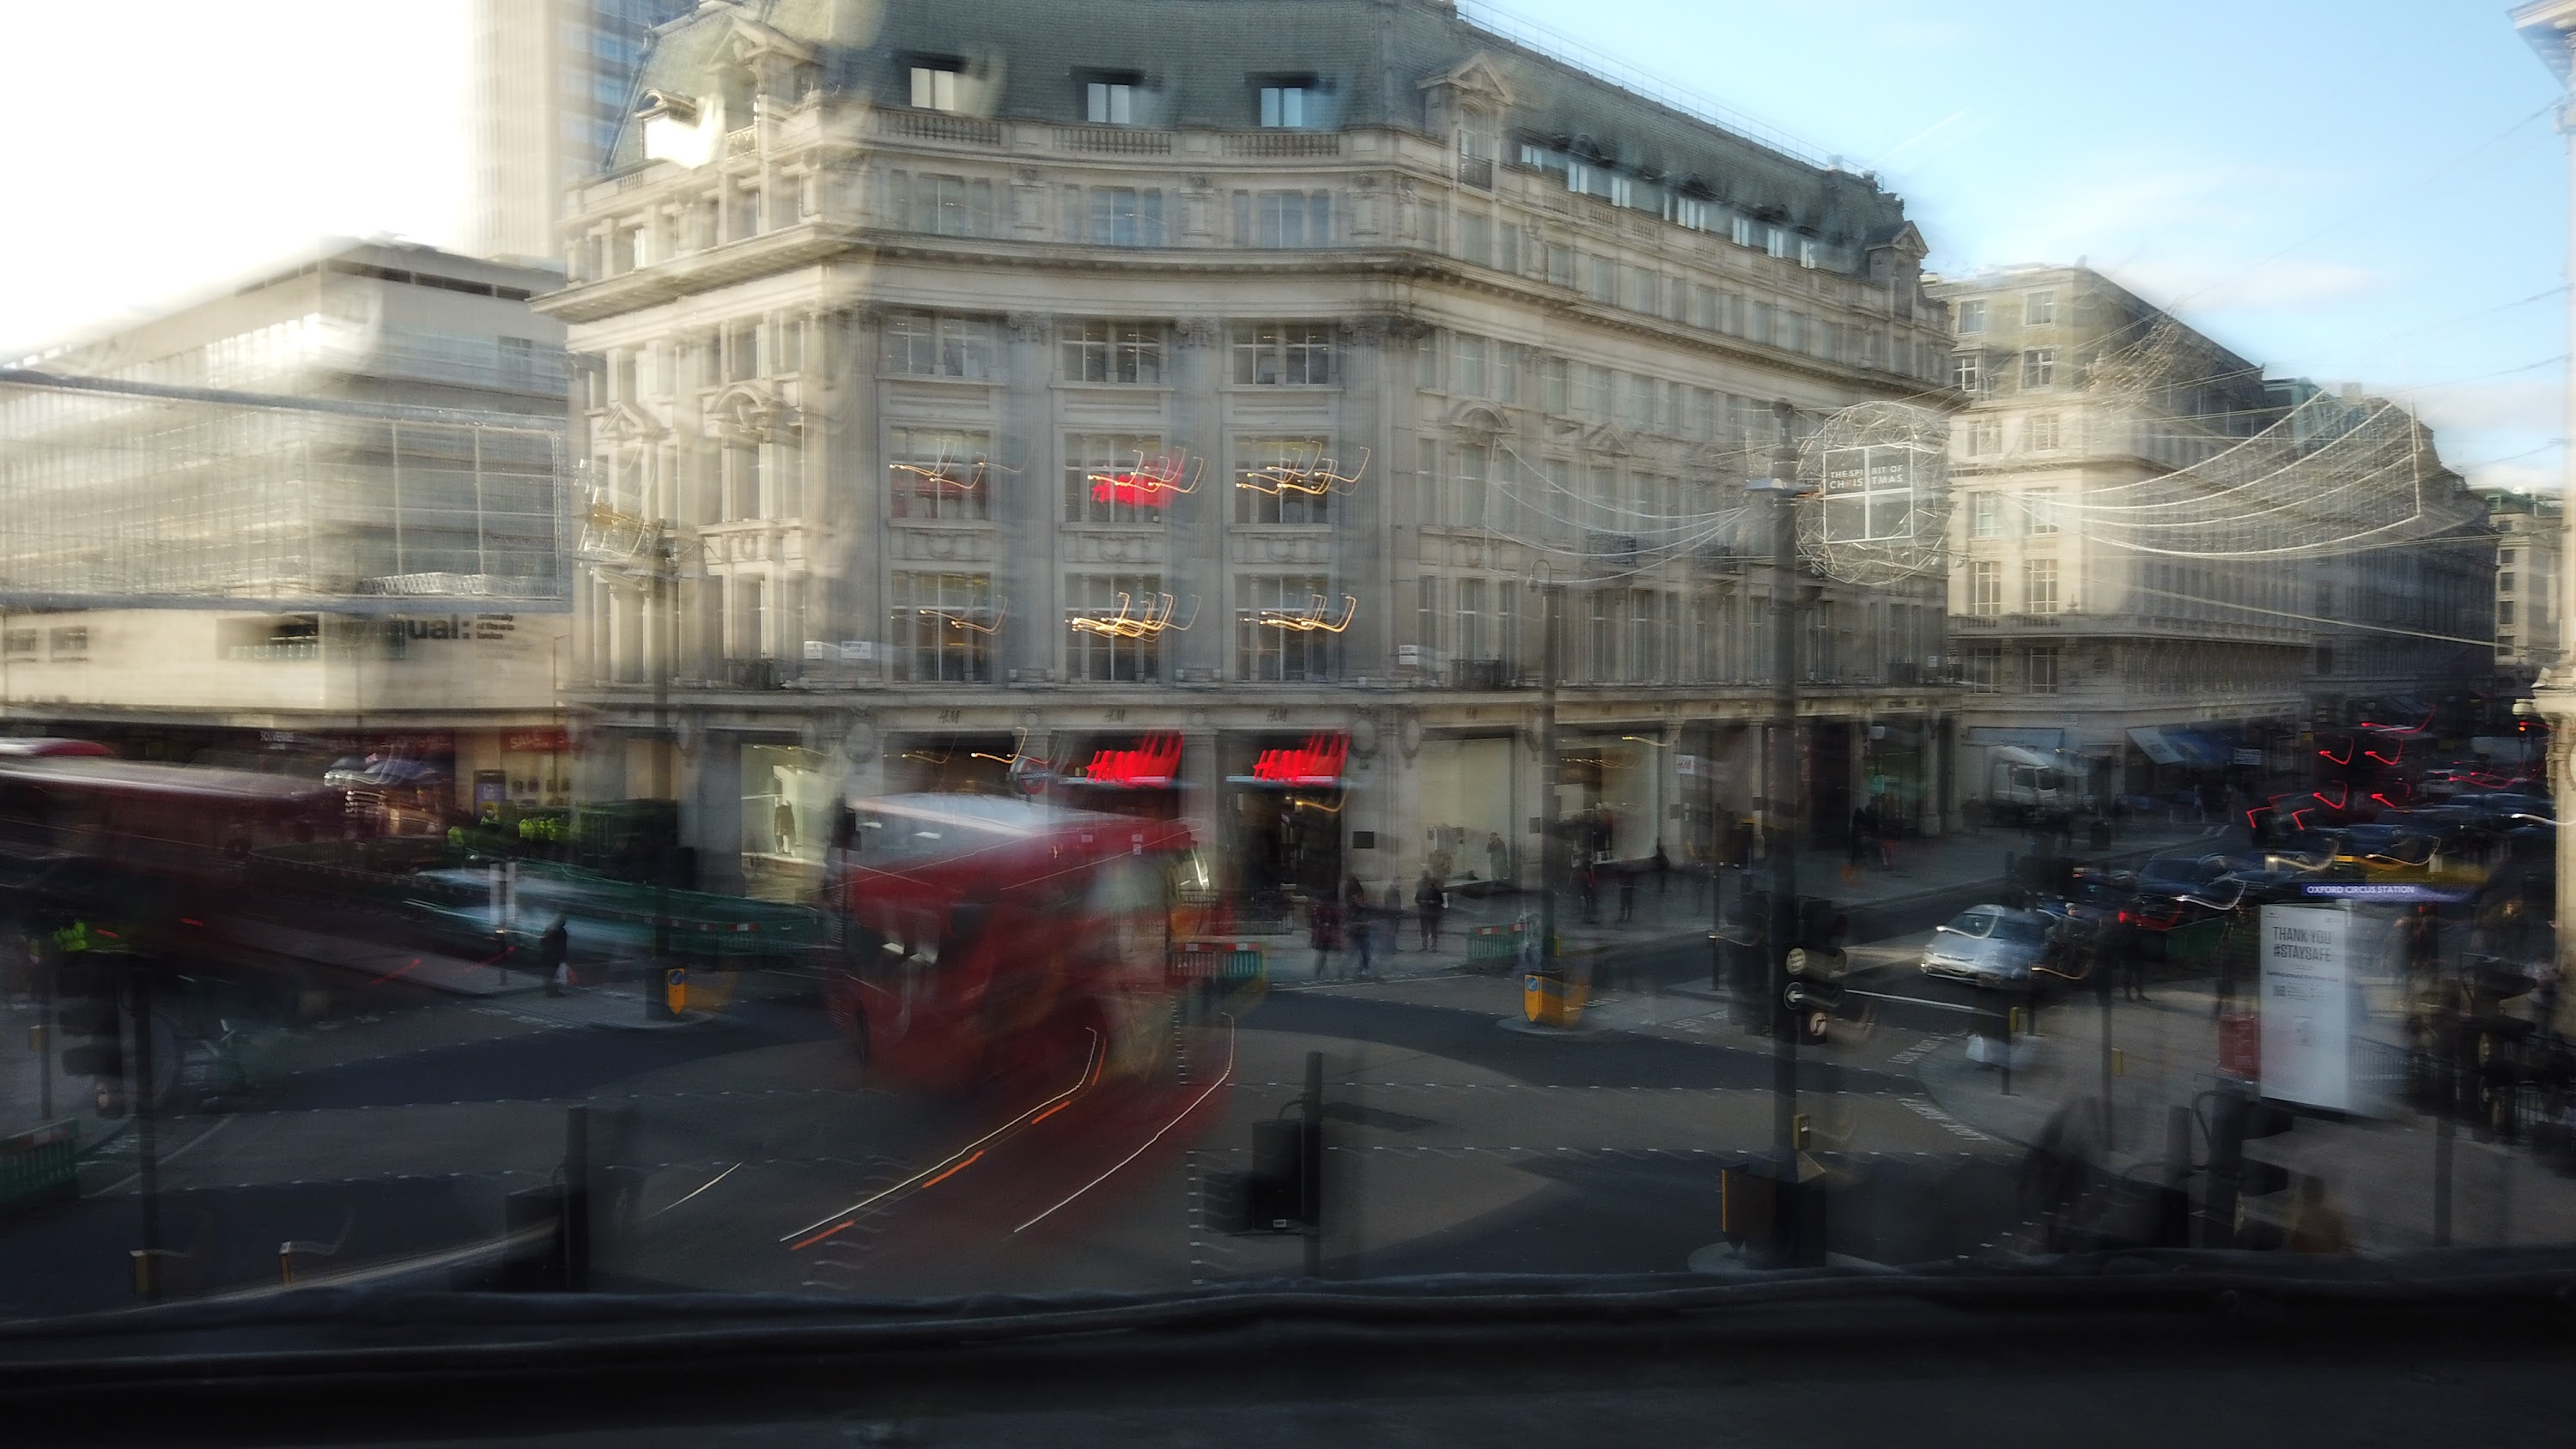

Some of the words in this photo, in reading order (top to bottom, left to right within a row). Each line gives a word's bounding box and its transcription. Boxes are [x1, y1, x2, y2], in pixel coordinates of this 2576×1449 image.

[1890, 464, 1904, 473] OF
[1829, 474, 1904, 489] CHISTMAS
[2306, 886, 2343, 894] OXFORD
[2273, 926, 2307, 943] THANK
[2311, 930, 2331, 944] YOU
[2273, 944, 2331, 962] #STAYSAFE
